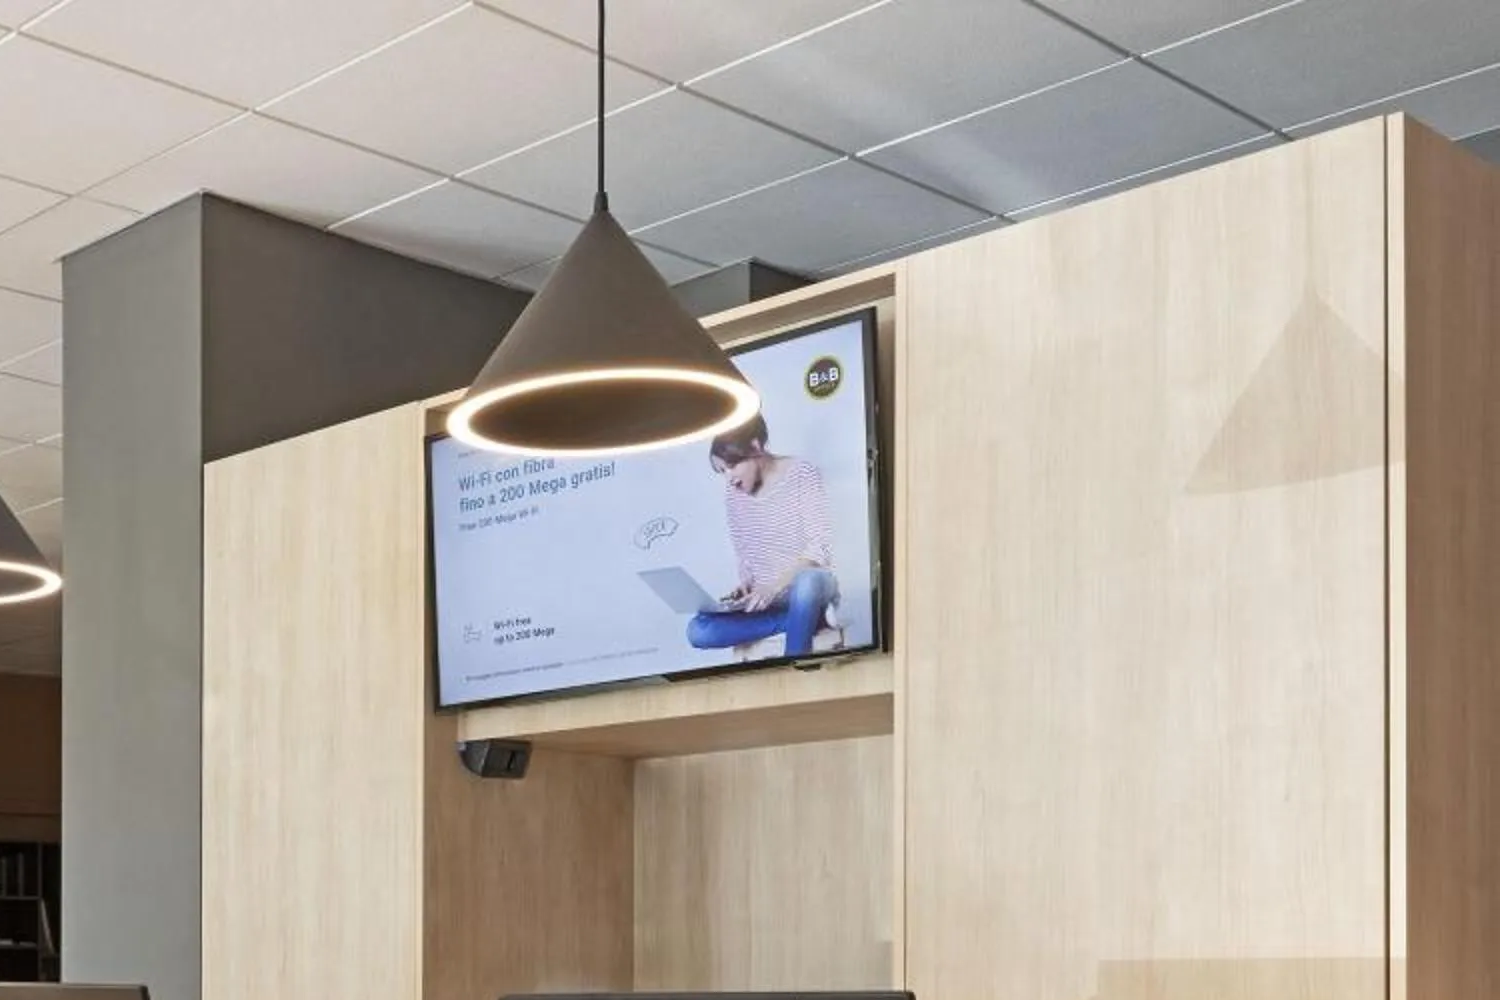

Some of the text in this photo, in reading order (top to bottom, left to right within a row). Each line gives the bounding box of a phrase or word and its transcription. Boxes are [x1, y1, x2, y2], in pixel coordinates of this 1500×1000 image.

[809, 367, 839, 387] B&B
[459, 458, 555, 491] Wi-Fi con fibra
[459, 496, 484, 513] fino
[500, 484, 525, 502] 200
[529, 477, 567, 496] Mega
[571, 461, 616, 488] gratis!
[516, 630, 531, 640] 200
[533, 627, 555, 638] Mega
